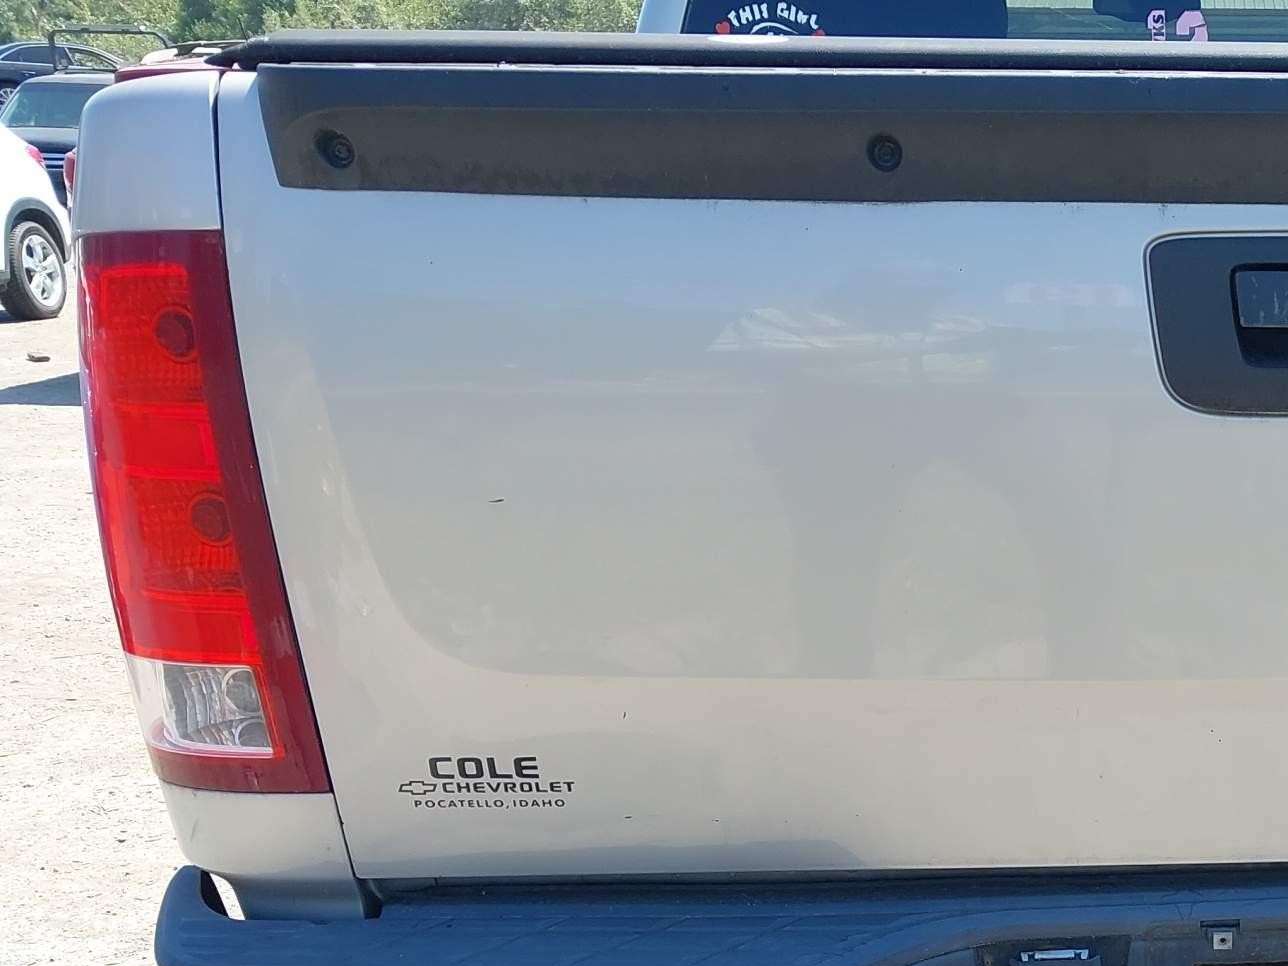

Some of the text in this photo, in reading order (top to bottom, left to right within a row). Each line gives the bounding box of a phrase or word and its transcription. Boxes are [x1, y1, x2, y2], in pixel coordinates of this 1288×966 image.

[727, 1, 819, 30] THIS GIRL
[428, 756, 540, 779] COLE
[441, 781, 575, 793] CHEVROLET
